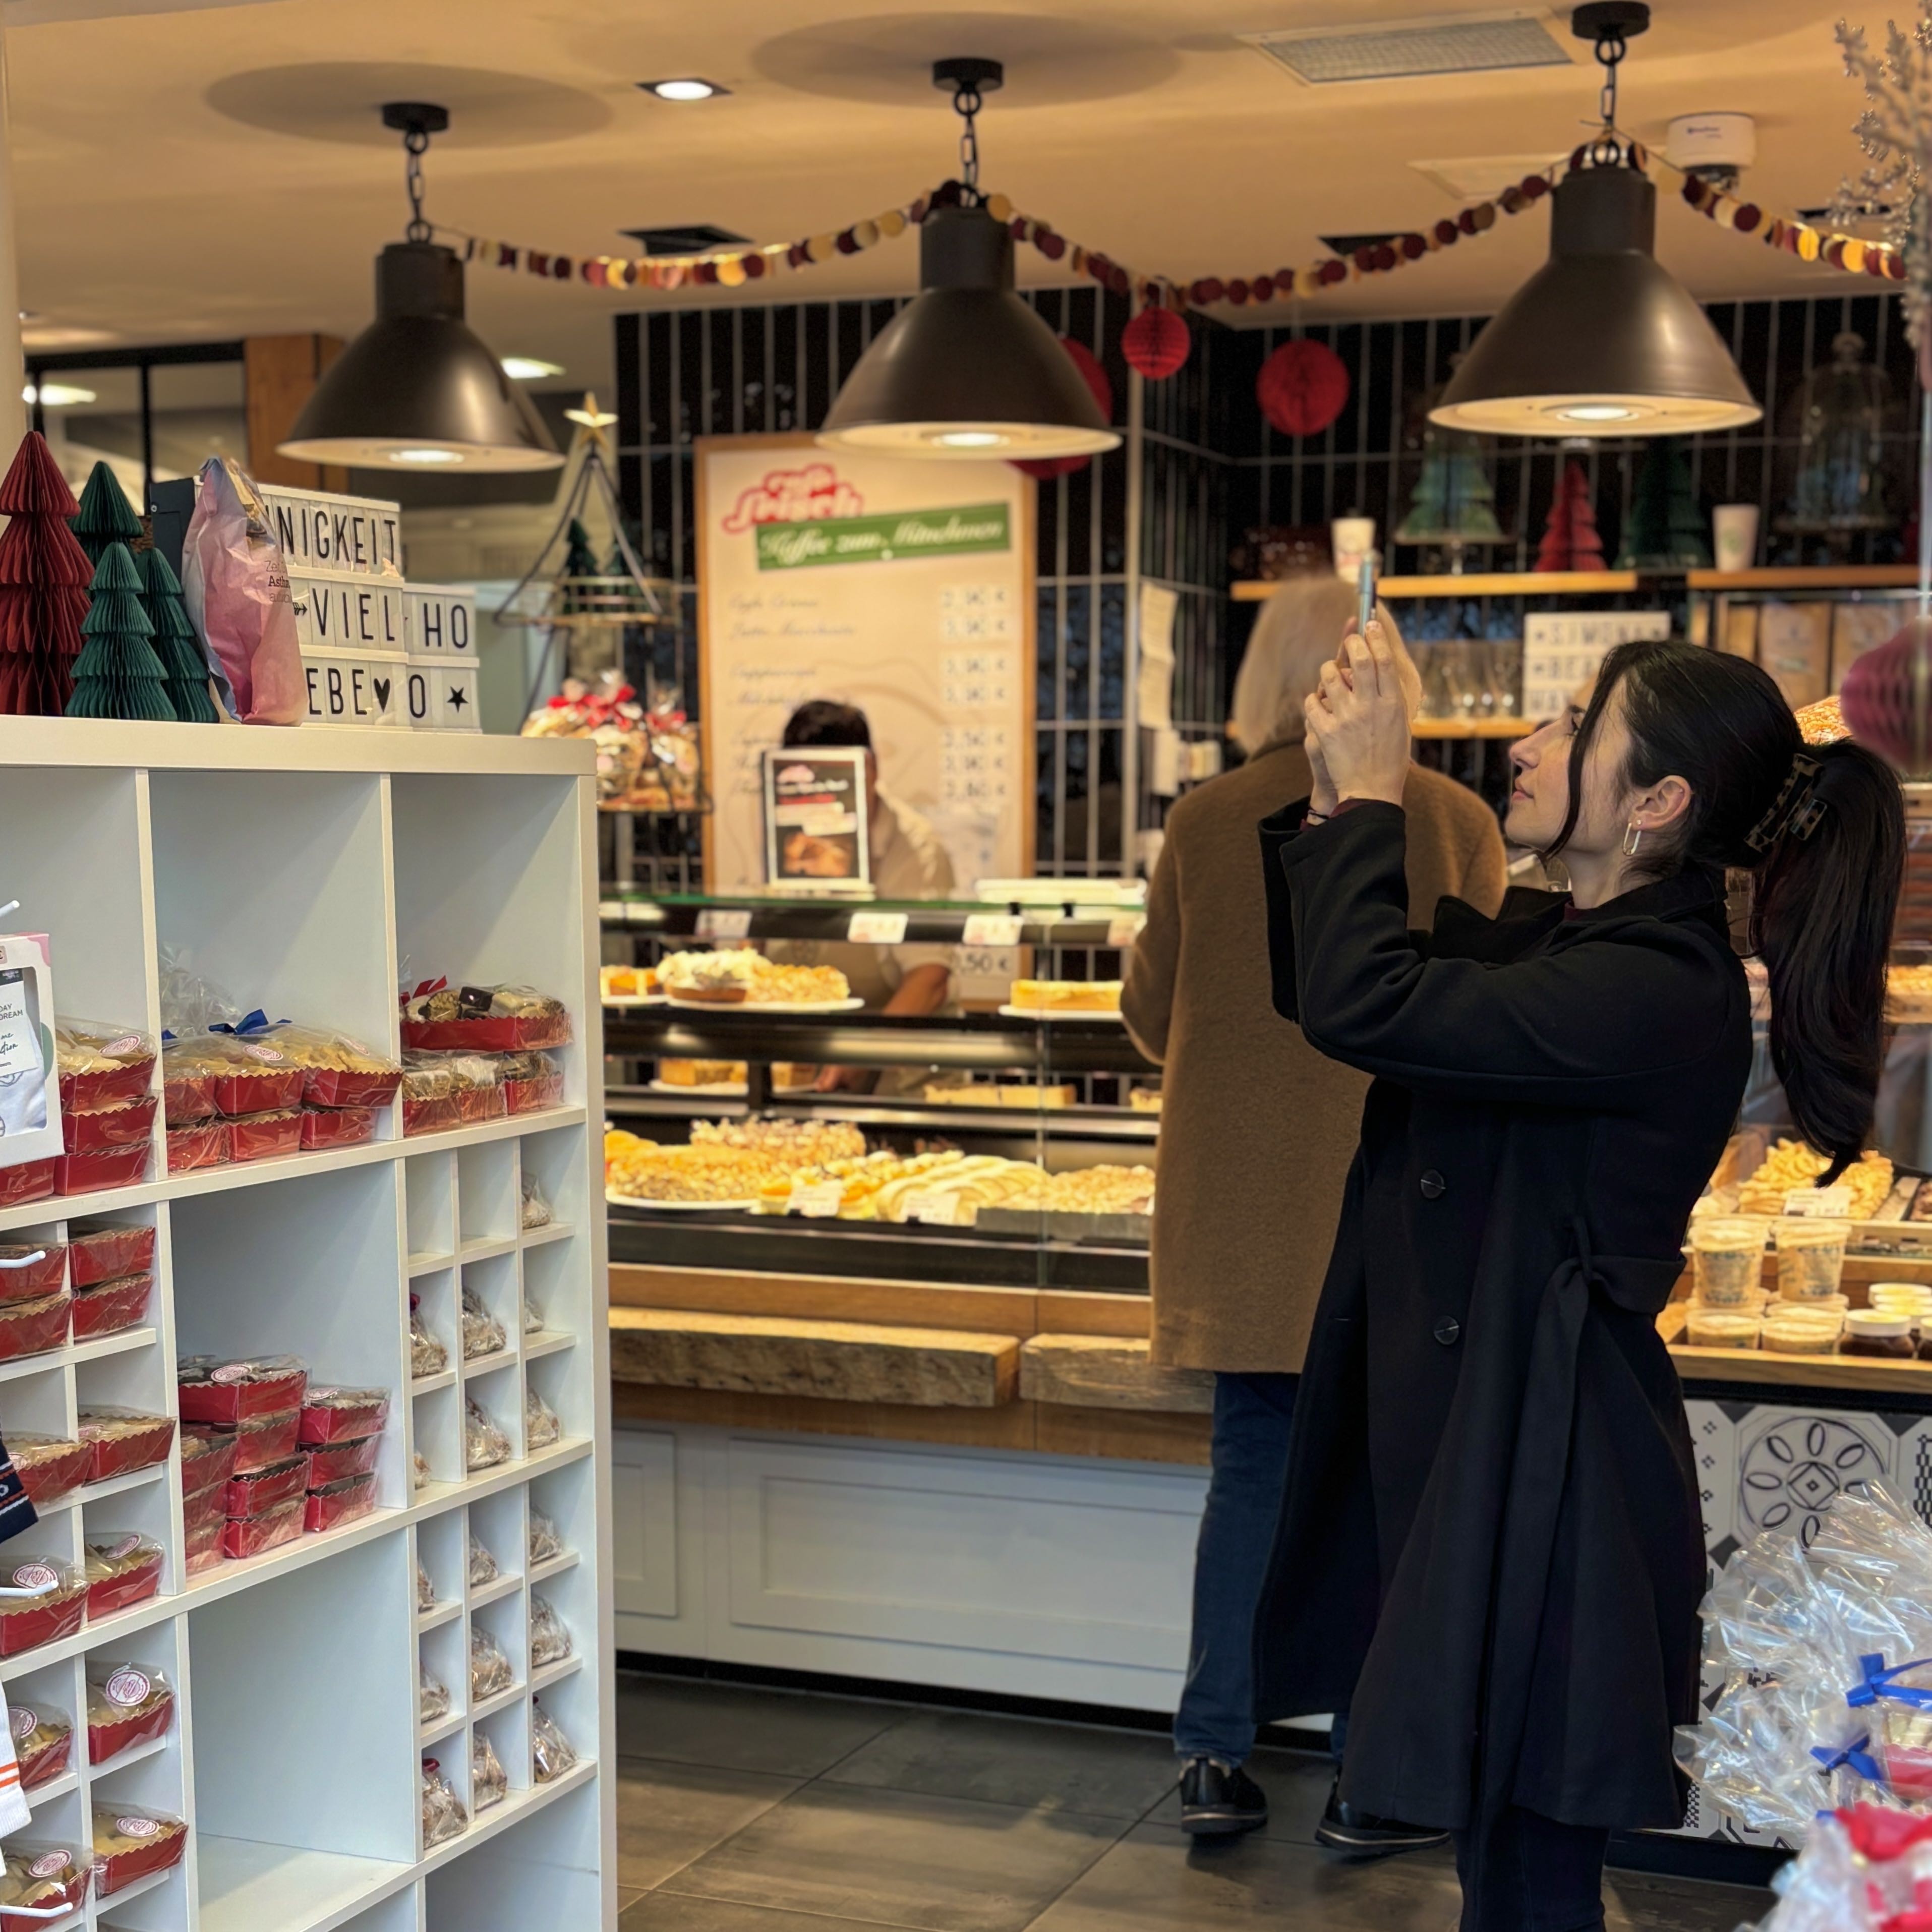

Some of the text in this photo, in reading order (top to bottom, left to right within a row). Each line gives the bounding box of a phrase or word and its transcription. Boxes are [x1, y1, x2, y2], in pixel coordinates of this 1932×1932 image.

[265, 505, 396, 564] NIGKEIT
[313, 588, 395, 641] VIEL
[424, 603, 467, 649] HO
[306, 668, 367, 715] EBE
